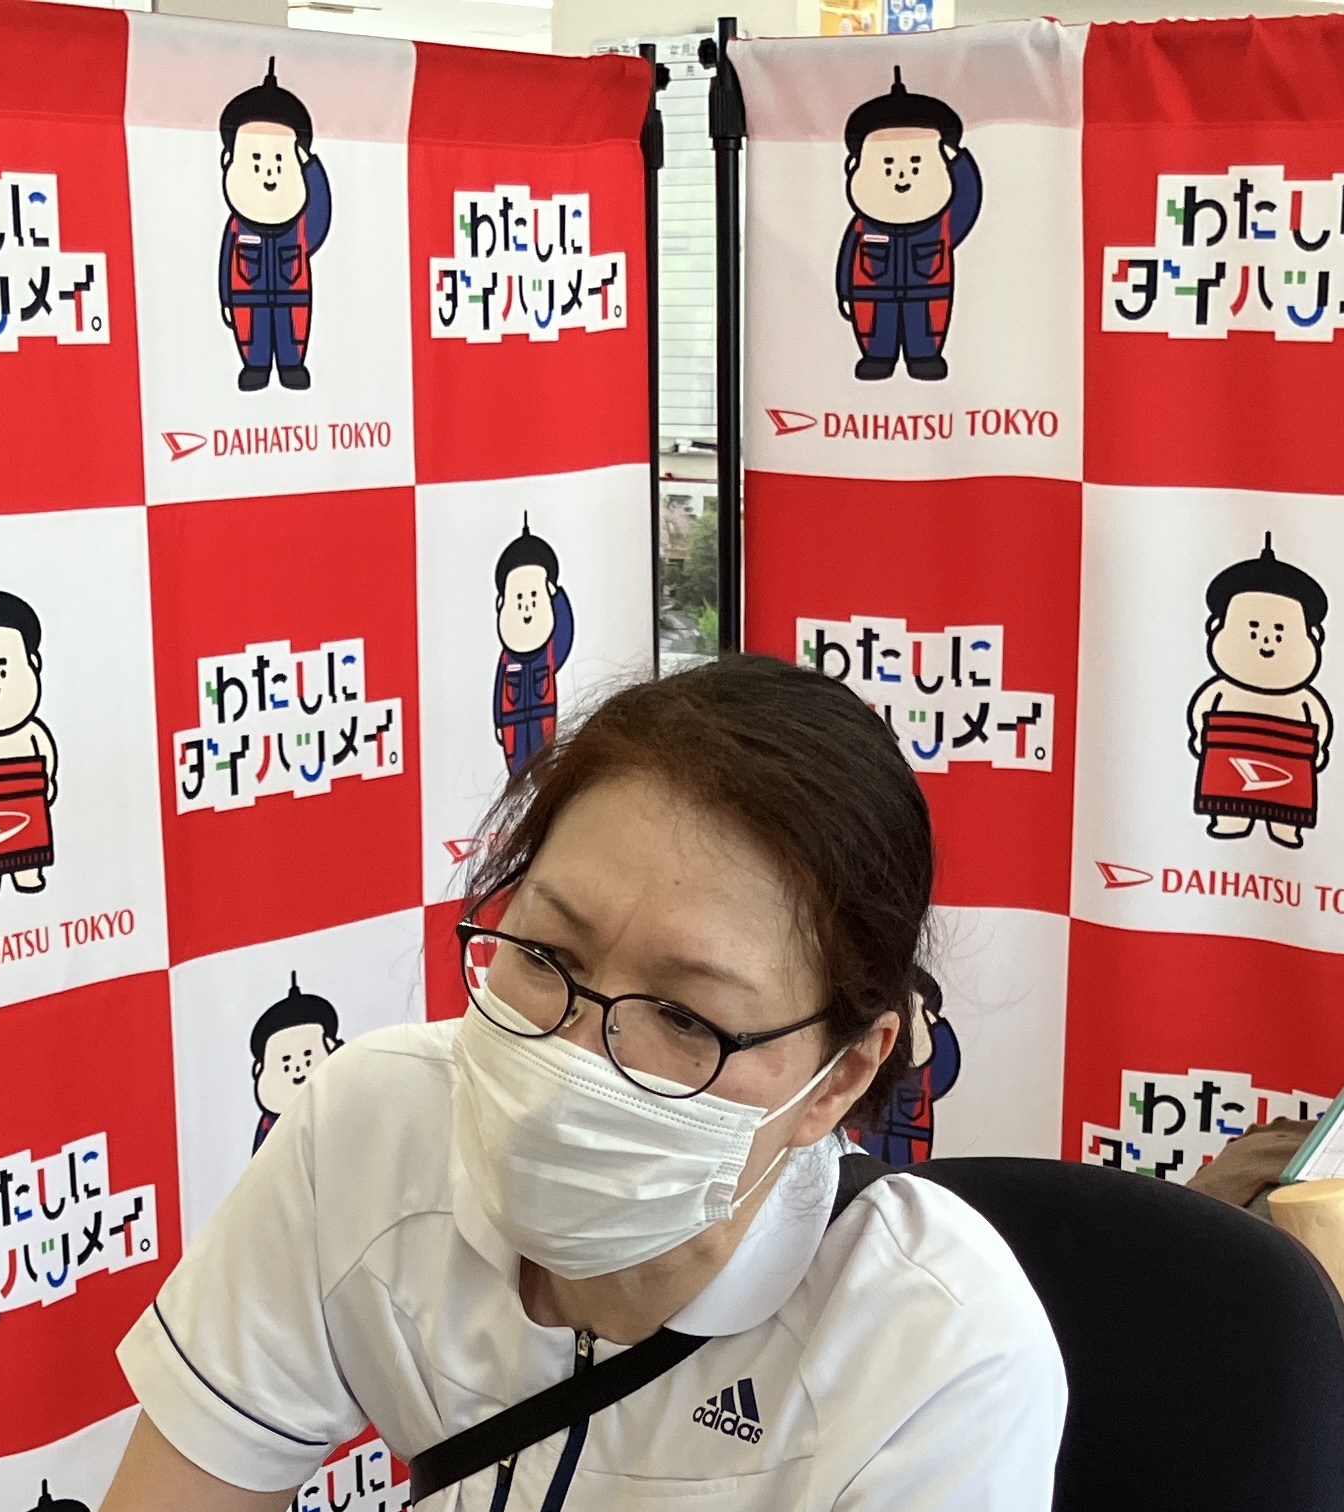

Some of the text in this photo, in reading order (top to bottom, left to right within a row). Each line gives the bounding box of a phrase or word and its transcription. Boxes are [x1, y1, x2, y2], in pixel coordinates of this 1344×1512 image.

[460, 197, 585, 262] わたしに
[436, 262, 624, 330] ダイハツメイ。
[213, 421, 392, 458] DAIHATSU TOKYO
[823, 409, 1058, 442] DAIHATSU TOKYO
[205, 653, 358, 723] わたしに
[803, 627, 991, 694] わたしに
[179, 709, 398, 801] ダイハツメイ。
[867, 702, 1046, 760] ツメイ。
[1161, 868, 1302, 908] DAIHATSU
[60, 907, 135, 951] TOKYO
[692, 1404, 763, 1444] adidas
